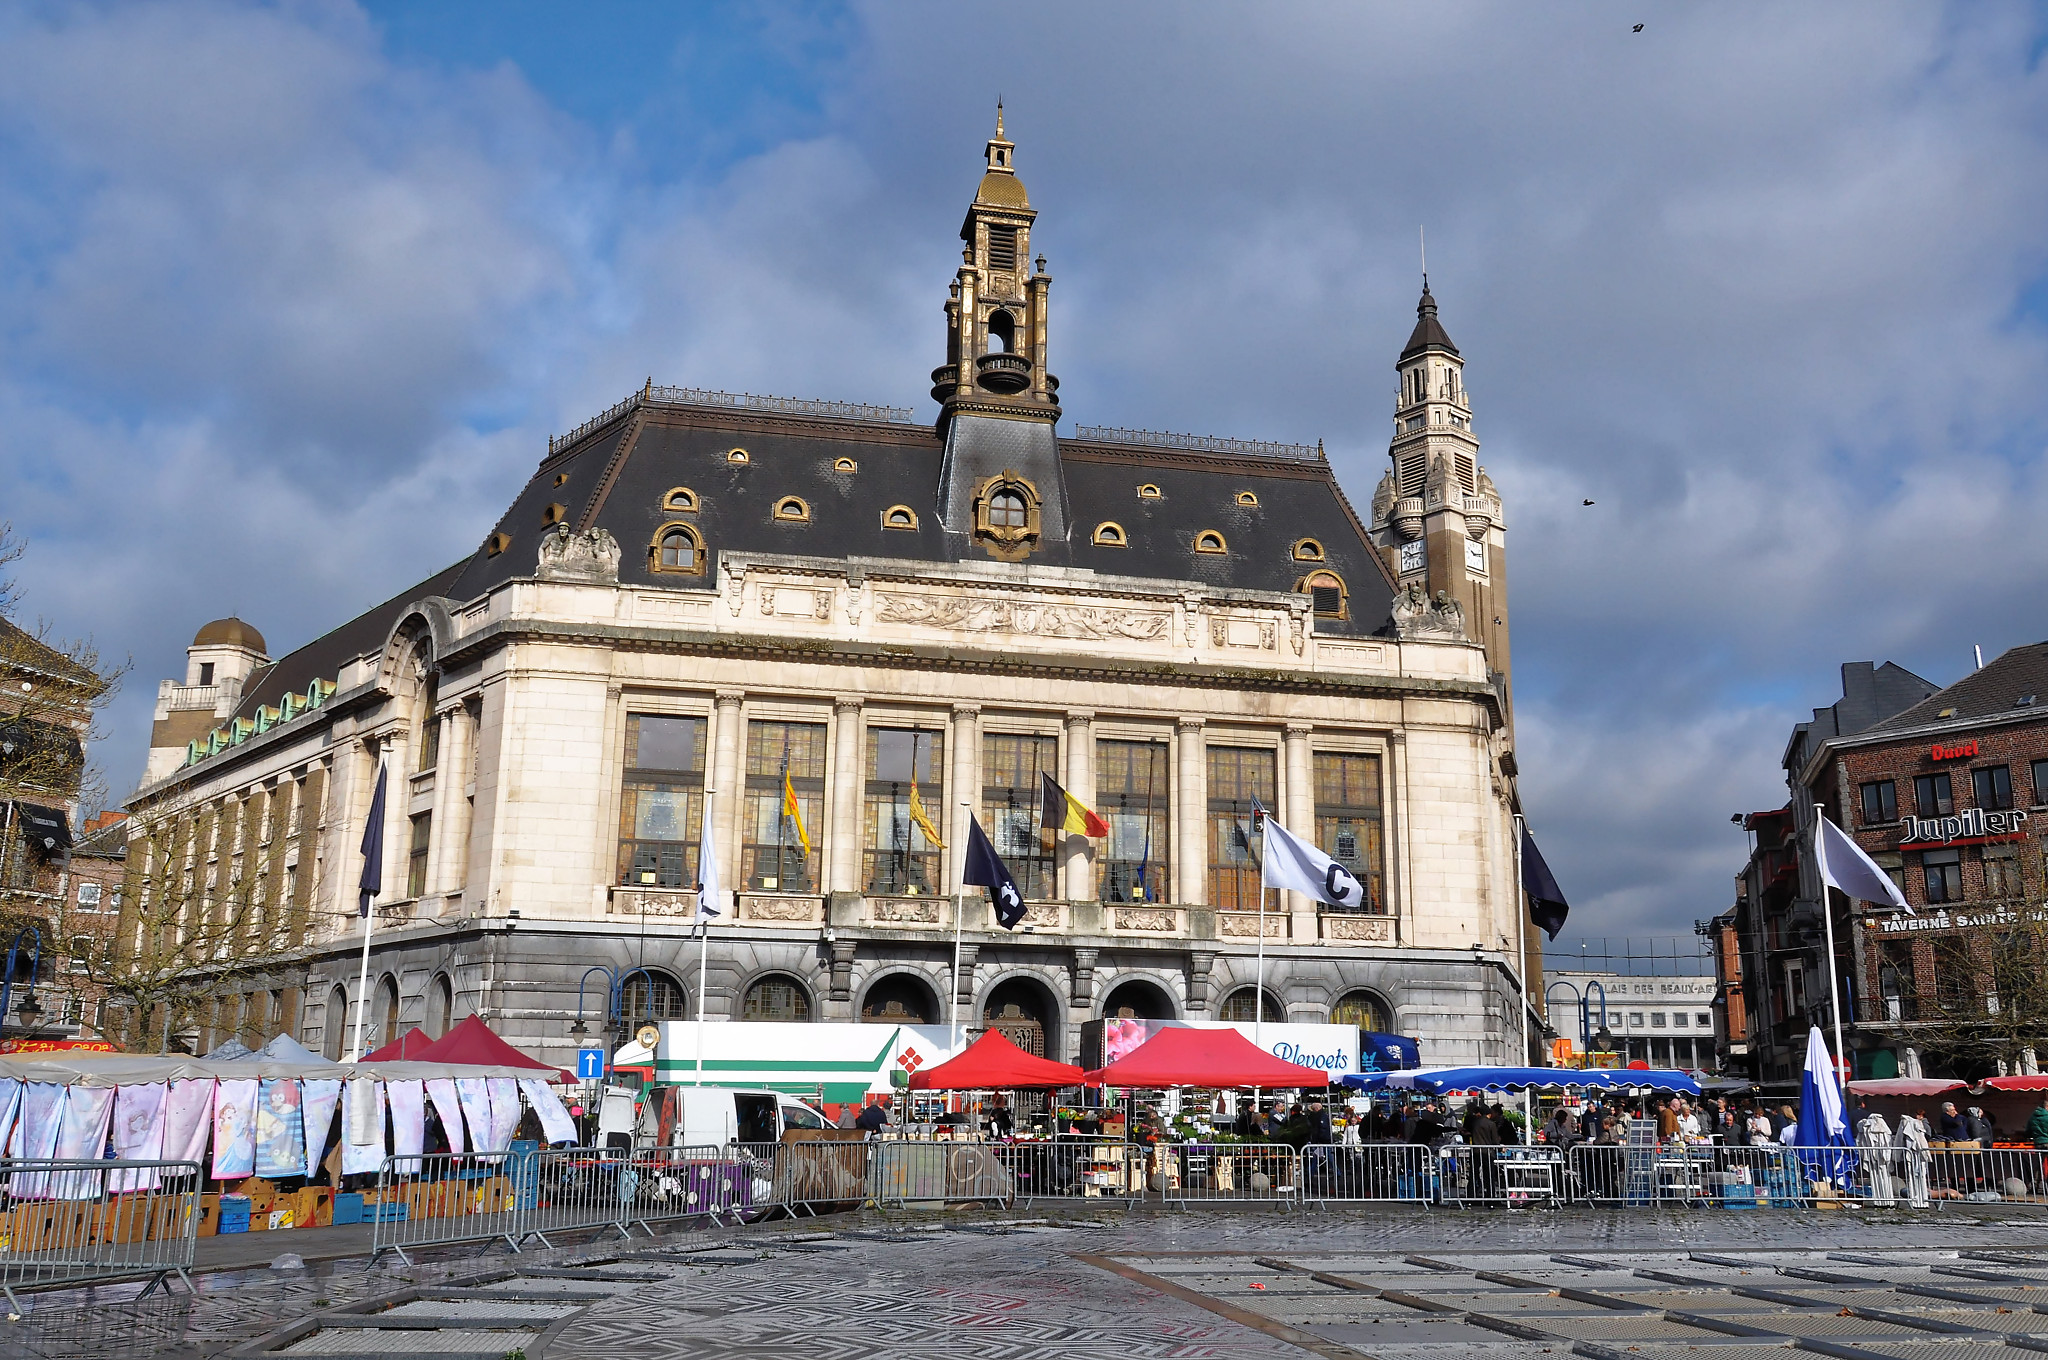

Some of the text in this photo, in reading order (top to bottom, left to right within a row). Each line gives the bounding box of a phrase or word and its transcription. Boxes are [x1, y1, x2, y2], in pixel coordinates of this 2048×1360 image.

[1931, 739, 1979, 761] Duvel
[1900, 807, 2028, 846] Jupiler
[1881, 917, 1951, 933] TAVERNE
[1591, 983, 1718, 995] PLAIS DES BEAUX-ART
[1272, 1041, 1349, 1070] Plevoets
